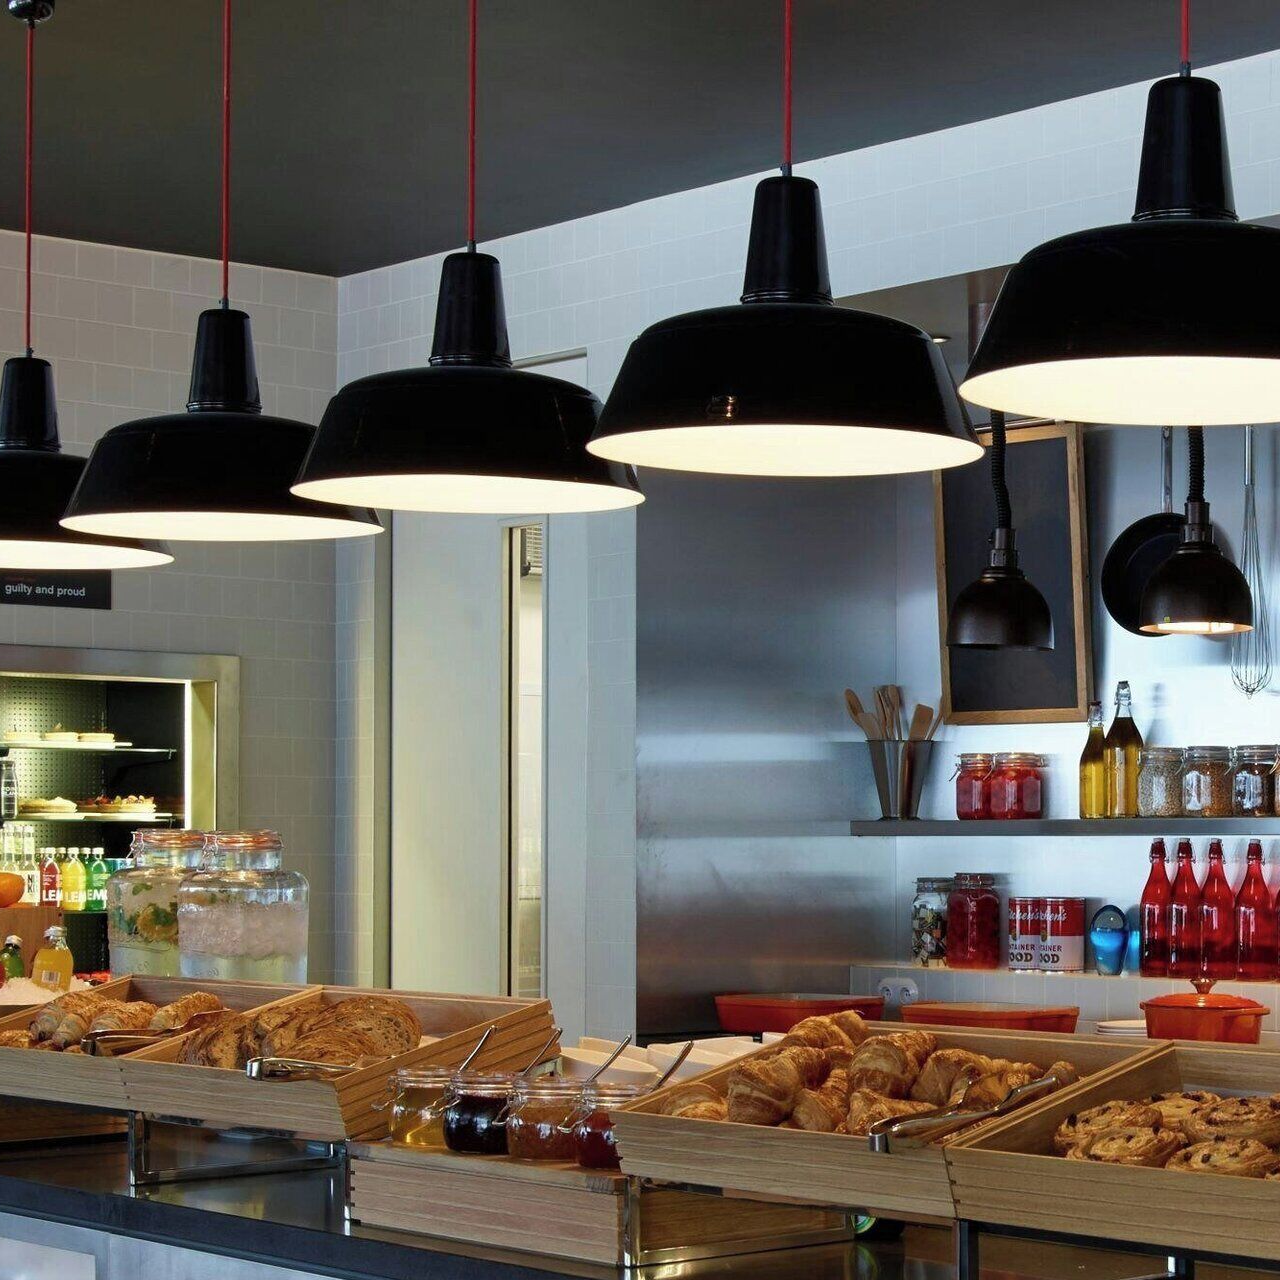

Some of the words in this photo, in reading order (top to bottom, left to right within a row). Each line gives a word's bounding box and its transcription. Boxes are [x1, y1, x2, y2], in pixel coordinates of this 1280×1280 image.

[5, 583, 32, 595] guilty
[35, 585, 54, 594] and
[57, 587, 86, 597] proud
